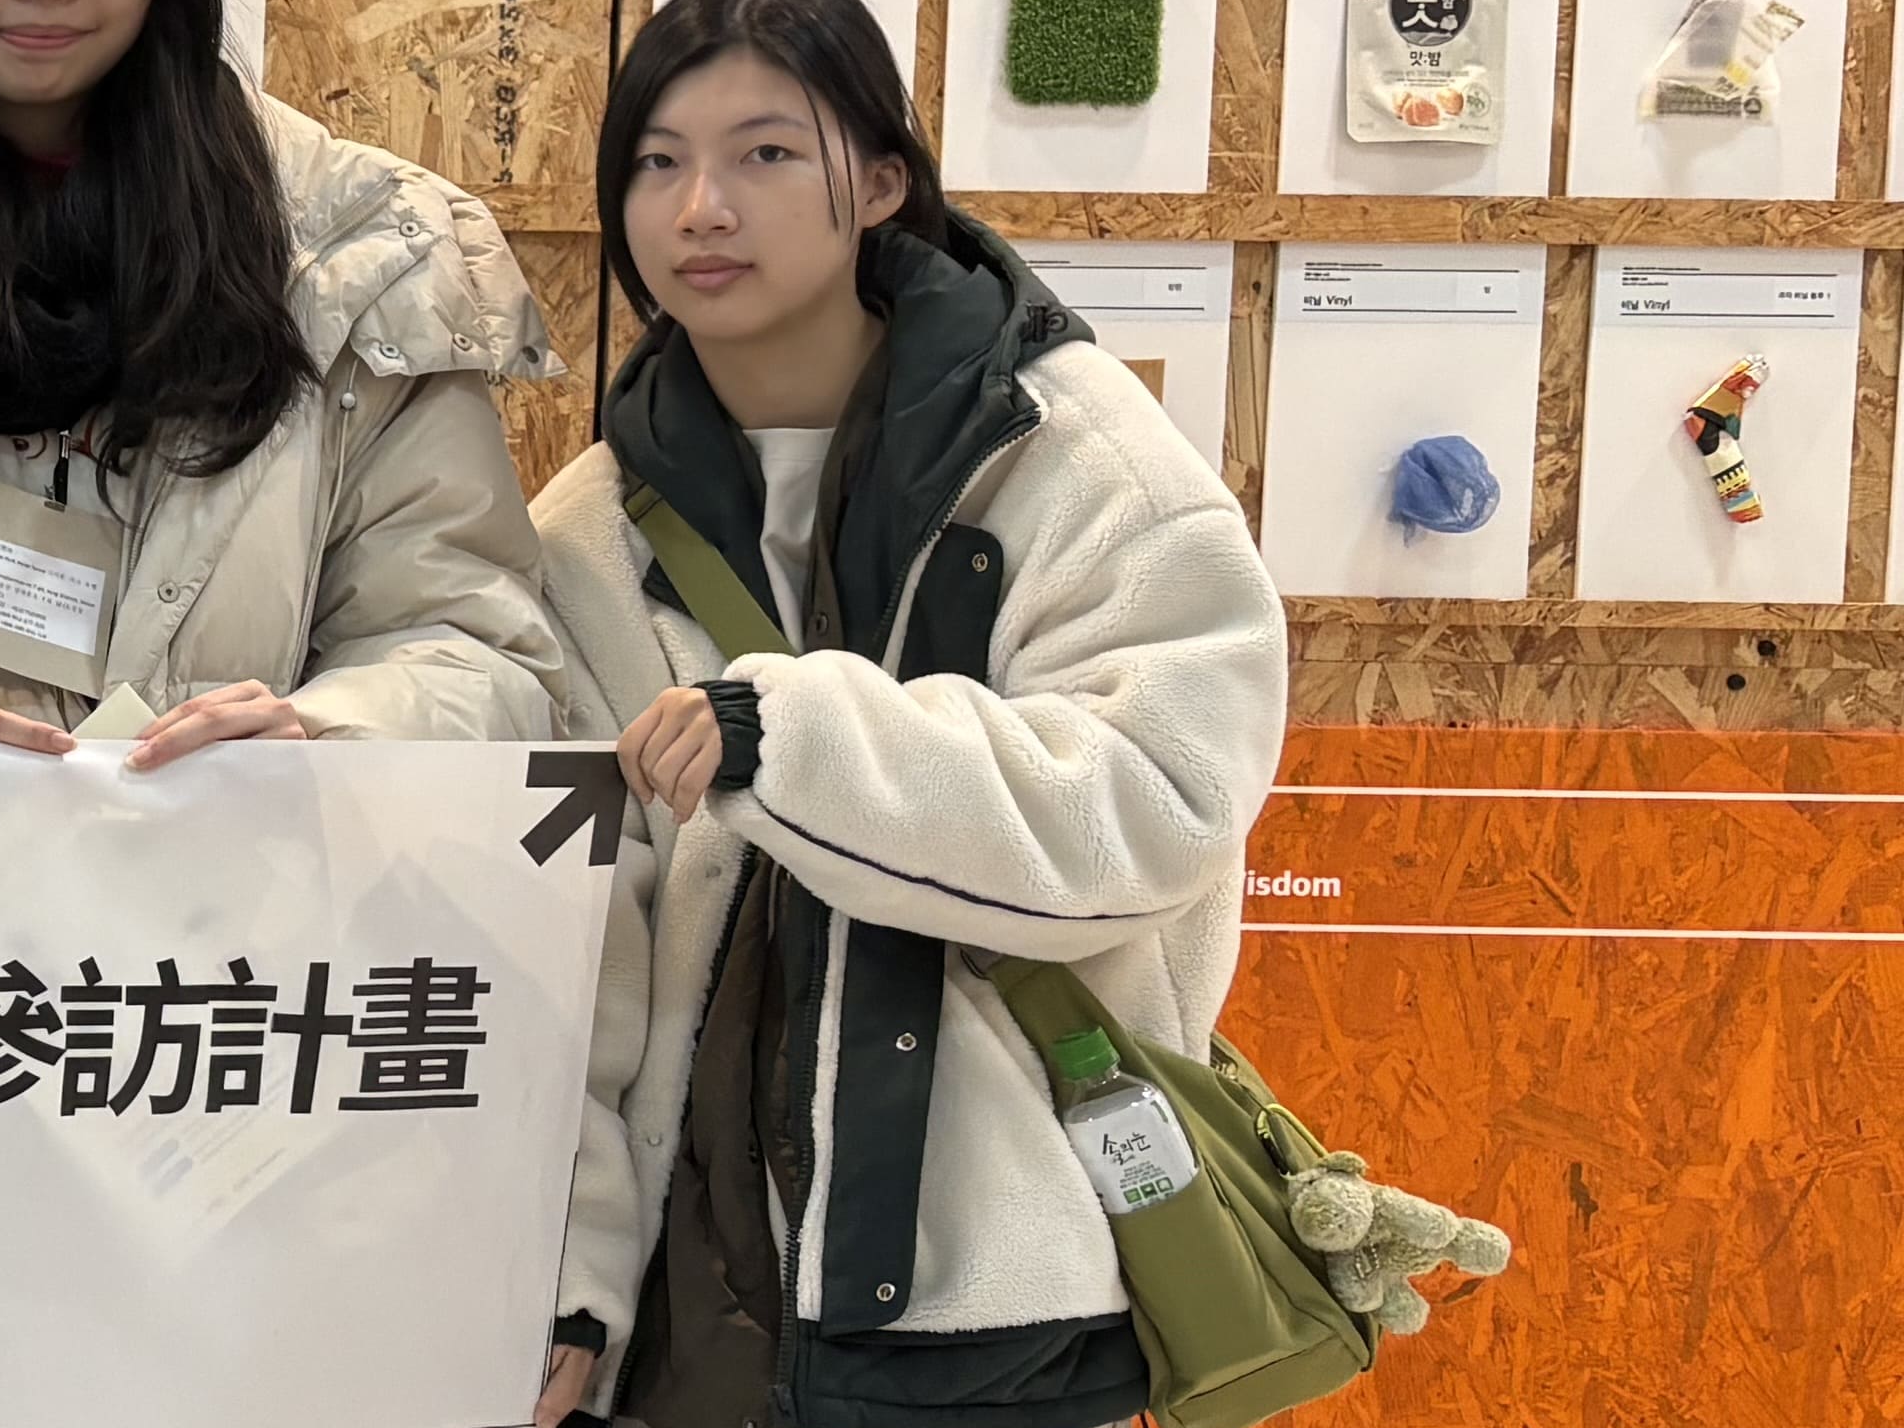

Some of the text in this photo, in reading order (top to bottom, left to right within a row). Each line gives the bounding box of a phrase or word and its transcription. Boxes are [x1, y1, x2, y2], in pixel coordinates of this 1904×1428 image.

[1327, 296, 1352, 306] Vinyl
[1644, 300, 1670, 311] Vinyl
[1245, 869, 1341, 897] isdom
